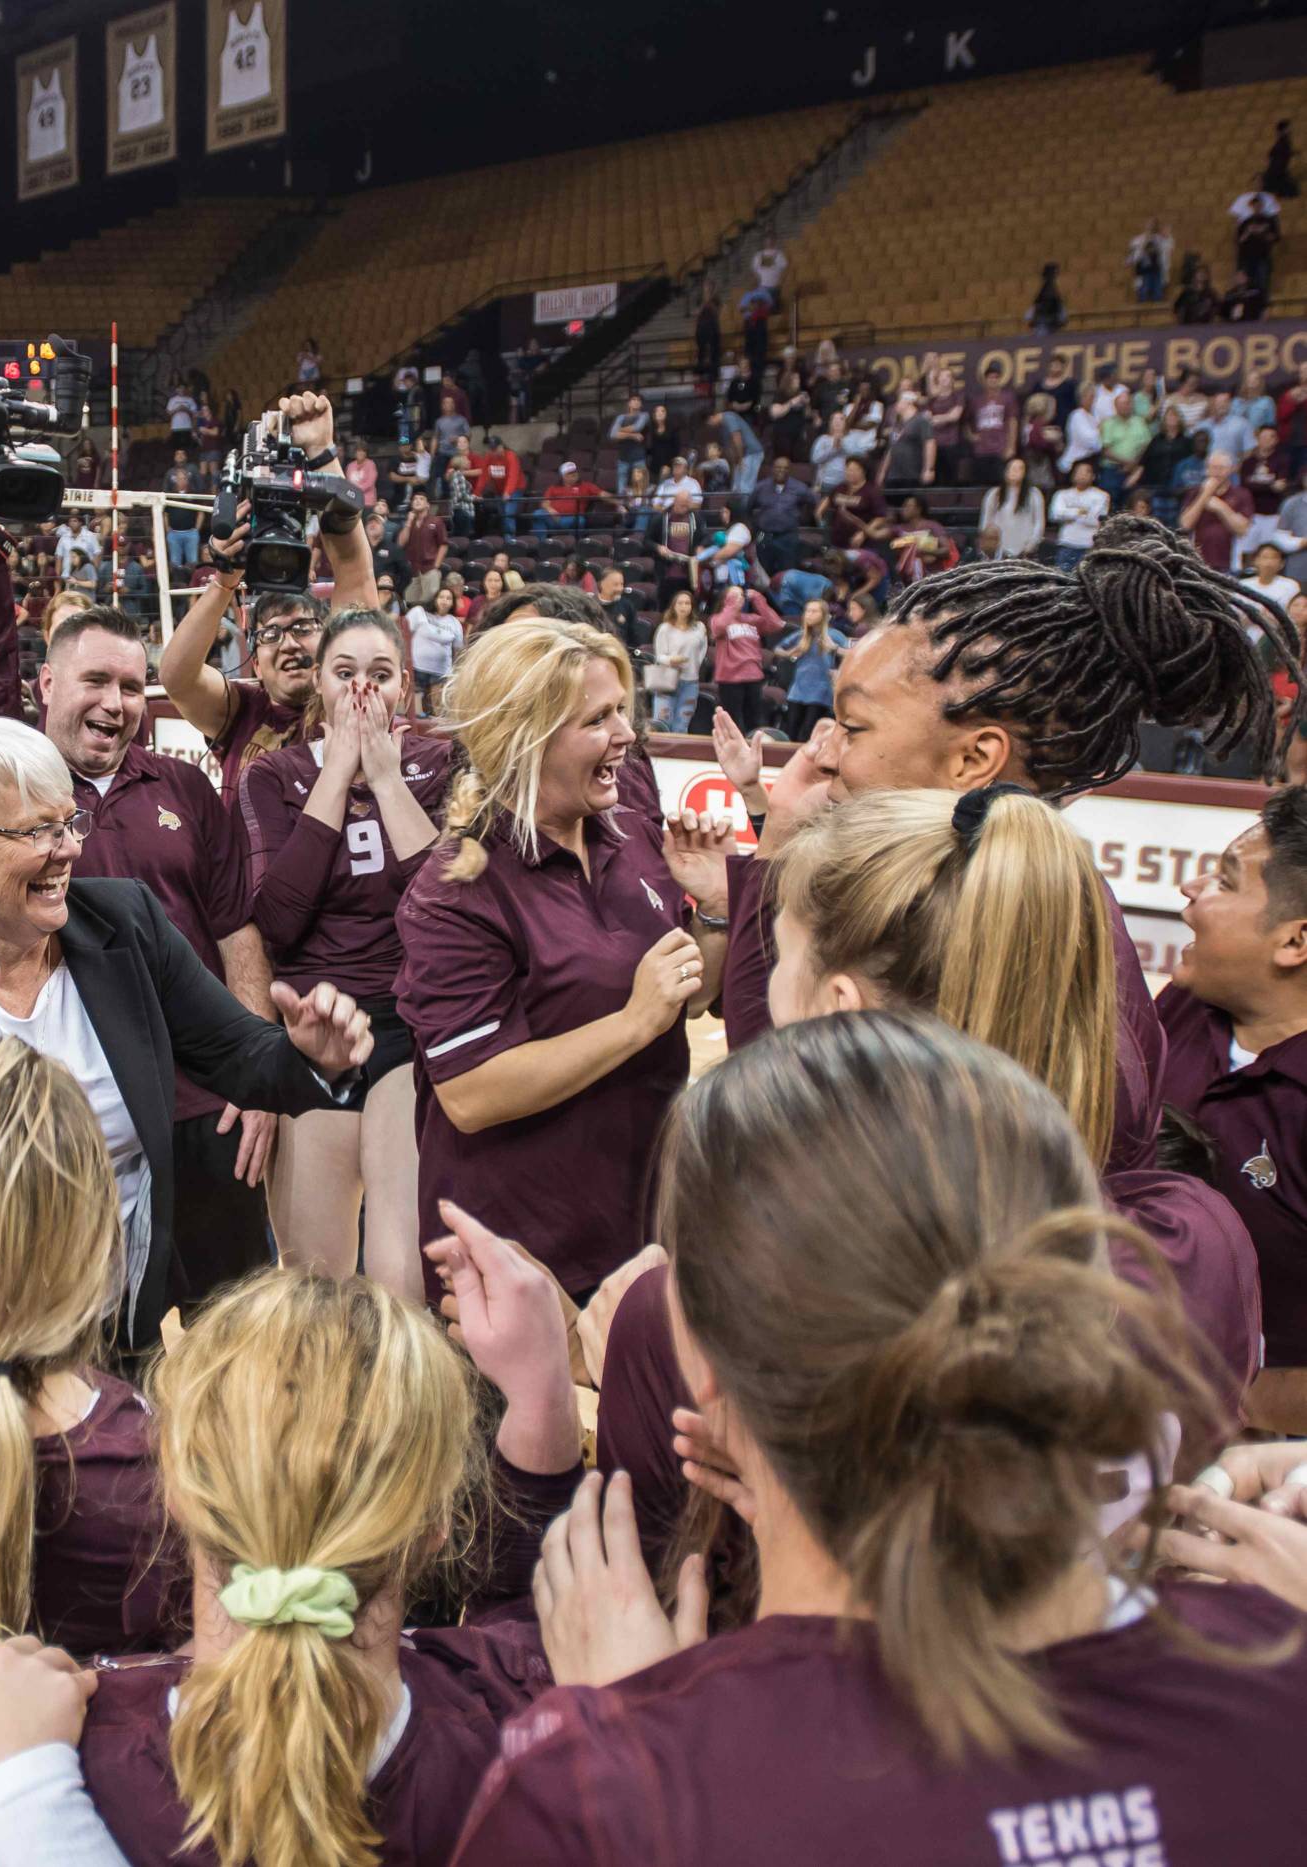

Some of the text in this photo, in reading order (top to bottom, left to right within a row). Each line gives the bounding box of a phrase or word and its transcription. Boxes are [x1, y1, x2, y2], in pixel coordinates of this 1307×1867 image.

[851, 47, 879, 88] J
[944, 30, 977, 70] K
[131, 75, 152, 100] 23
[871, 351, 966, 394] OME
[978, 347, 1043, 389] OF
[1050, 340, 1151, 389] THE
[346, 819, 386, 876] 9
[1136, 846, 1224, 888] STA
[988, 1785, 1159, 1864] TEXAS
